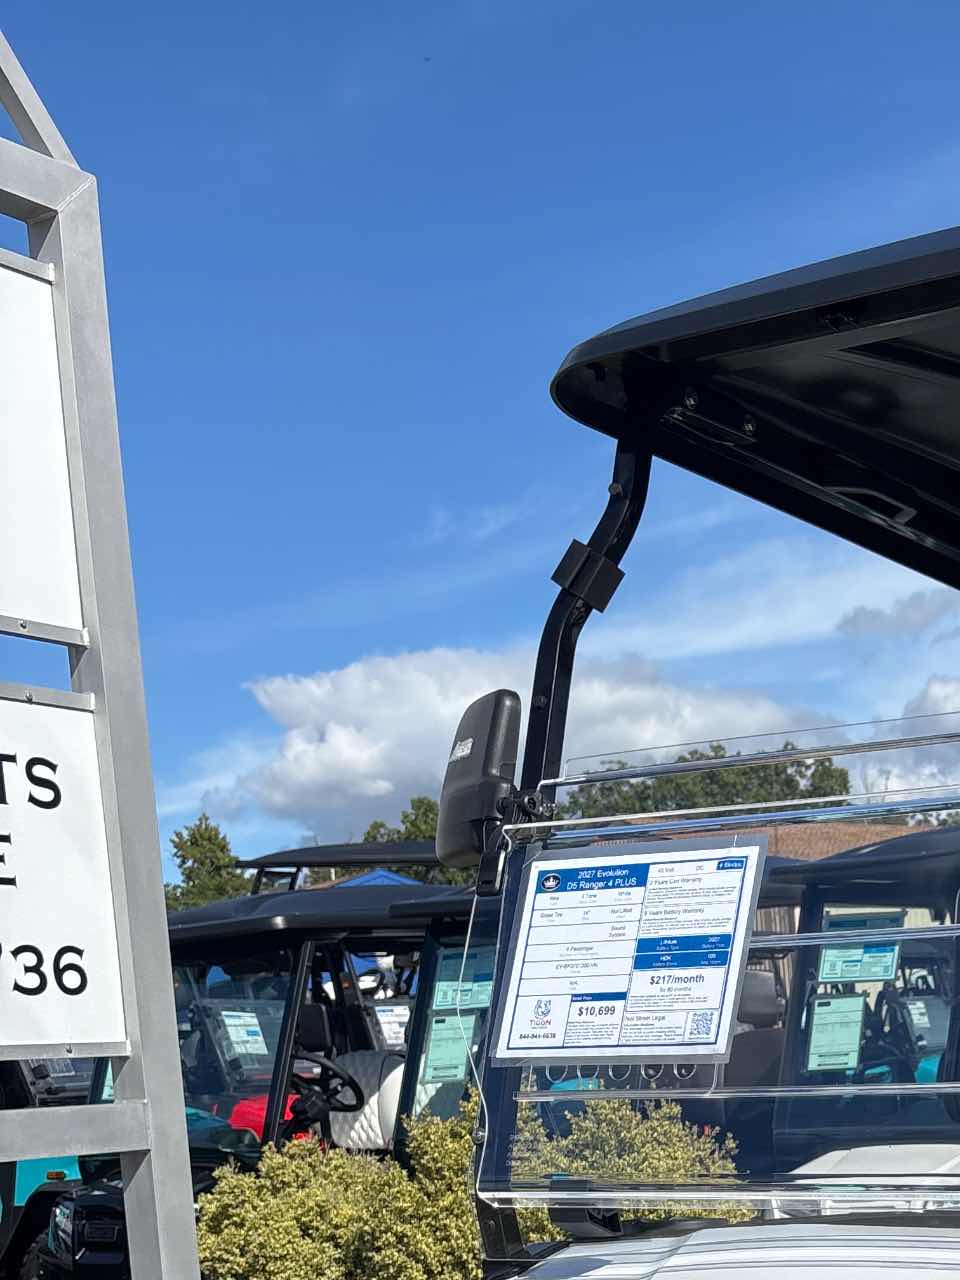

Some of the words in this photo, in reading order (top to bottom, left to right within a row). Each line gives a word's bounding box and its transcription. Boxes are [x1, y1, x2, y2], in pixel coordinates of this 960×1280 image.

[578, 871, 596, 879] 2027
[597, 869, 629, 878] Evolution
[567, 881, 578, 890] D5
[580, 880, 607, 891] Ranger
[615, 878, 637, 887] PLUS
[0, 943, 88, 996] 36
[650, 974, 705, 985] $217/month
[577, 1005, 616, 1017] $10,699
